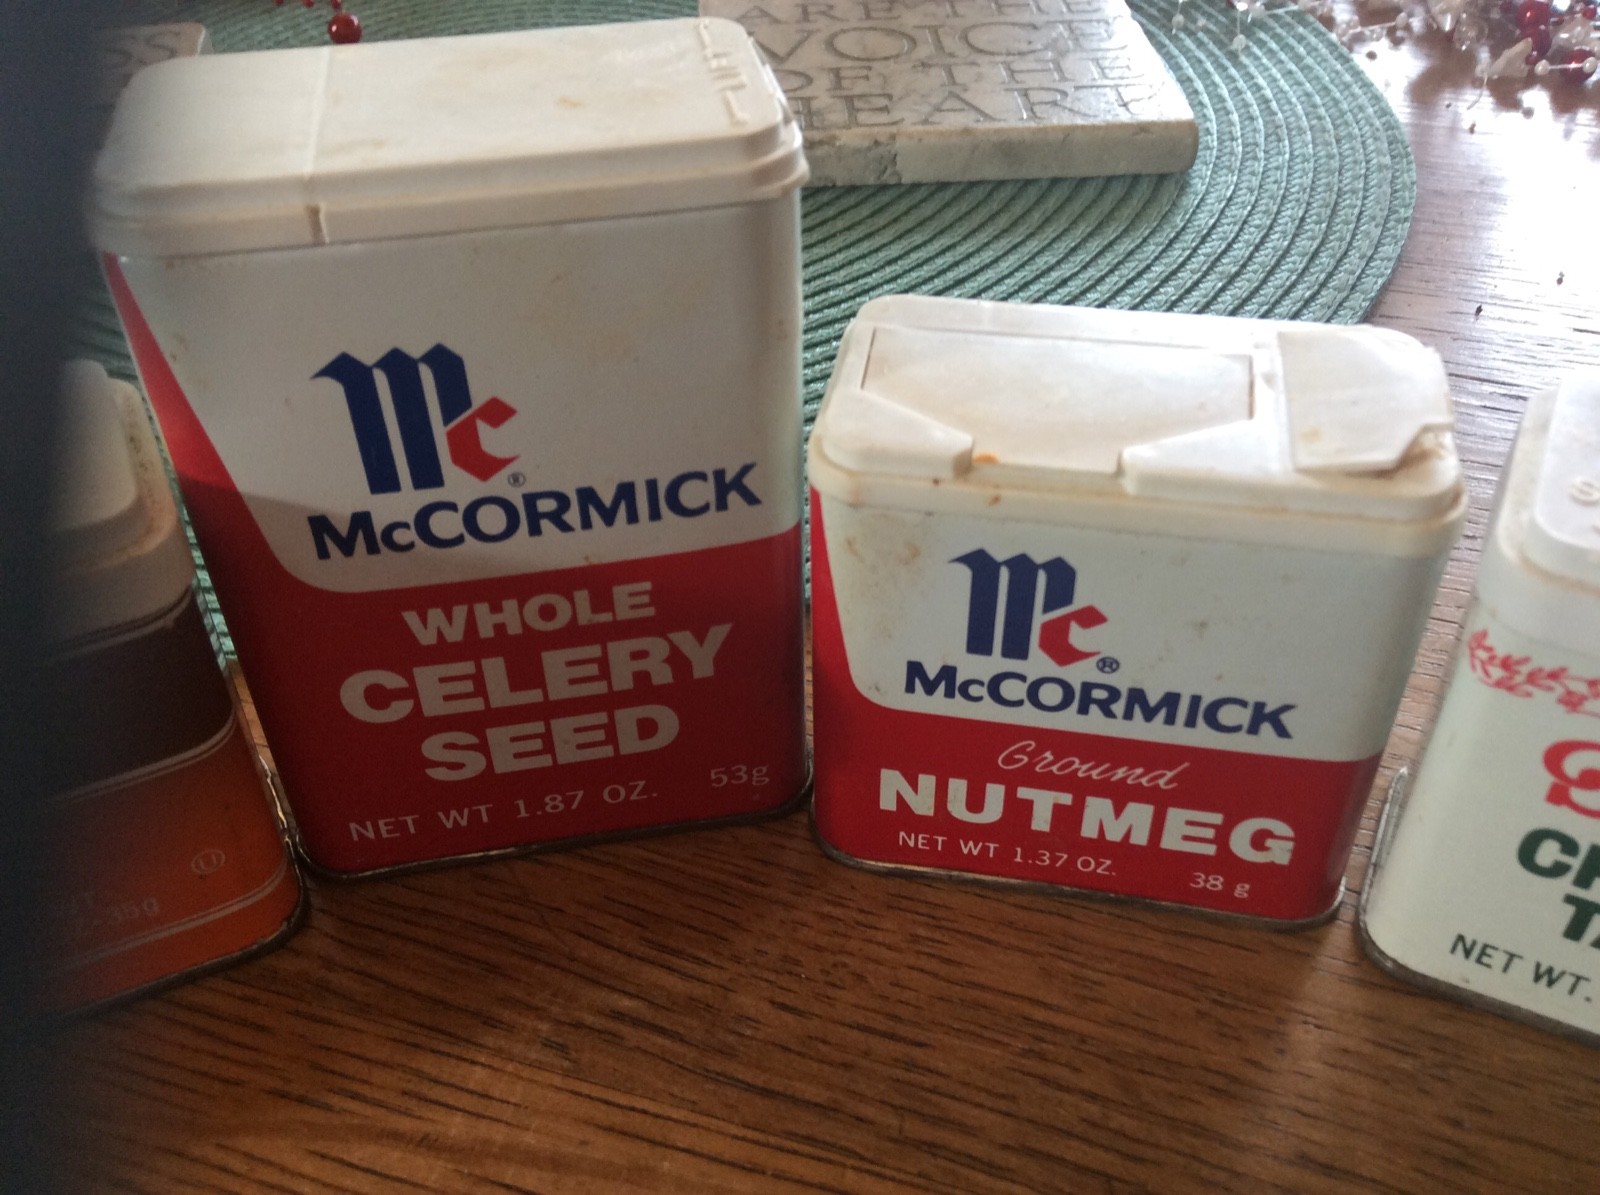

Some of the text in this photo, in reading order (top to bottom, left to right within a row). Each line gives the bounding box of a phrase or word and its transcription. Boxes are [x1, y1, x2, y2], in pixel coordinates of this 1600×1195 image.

[747, 15, 1128, 62] VOICE
[911, 57, 1144, 92] THE
[307, 462, 762, 560] McCORMICK
[402, 581, 655, 646] WHOLE
[339, 623, 733, 724] CELERY
[904, 660, 1298, 739] McCORMICK
[420, 704, 679, 781] SEED
[997, 740, 1191, 790] Ground
[710, 765, 770, 789] 53g
[349, 780, 658, 842] NET WT 1.87 OZ.
[879, 768, 1295, 866] NUTMEG
[898, 830, 1117, 877] NET WT 1.37 OZ.
[1189, 872, 1251, 899] 38 g
[1449, 932, 1592, 1003] NET WT.
